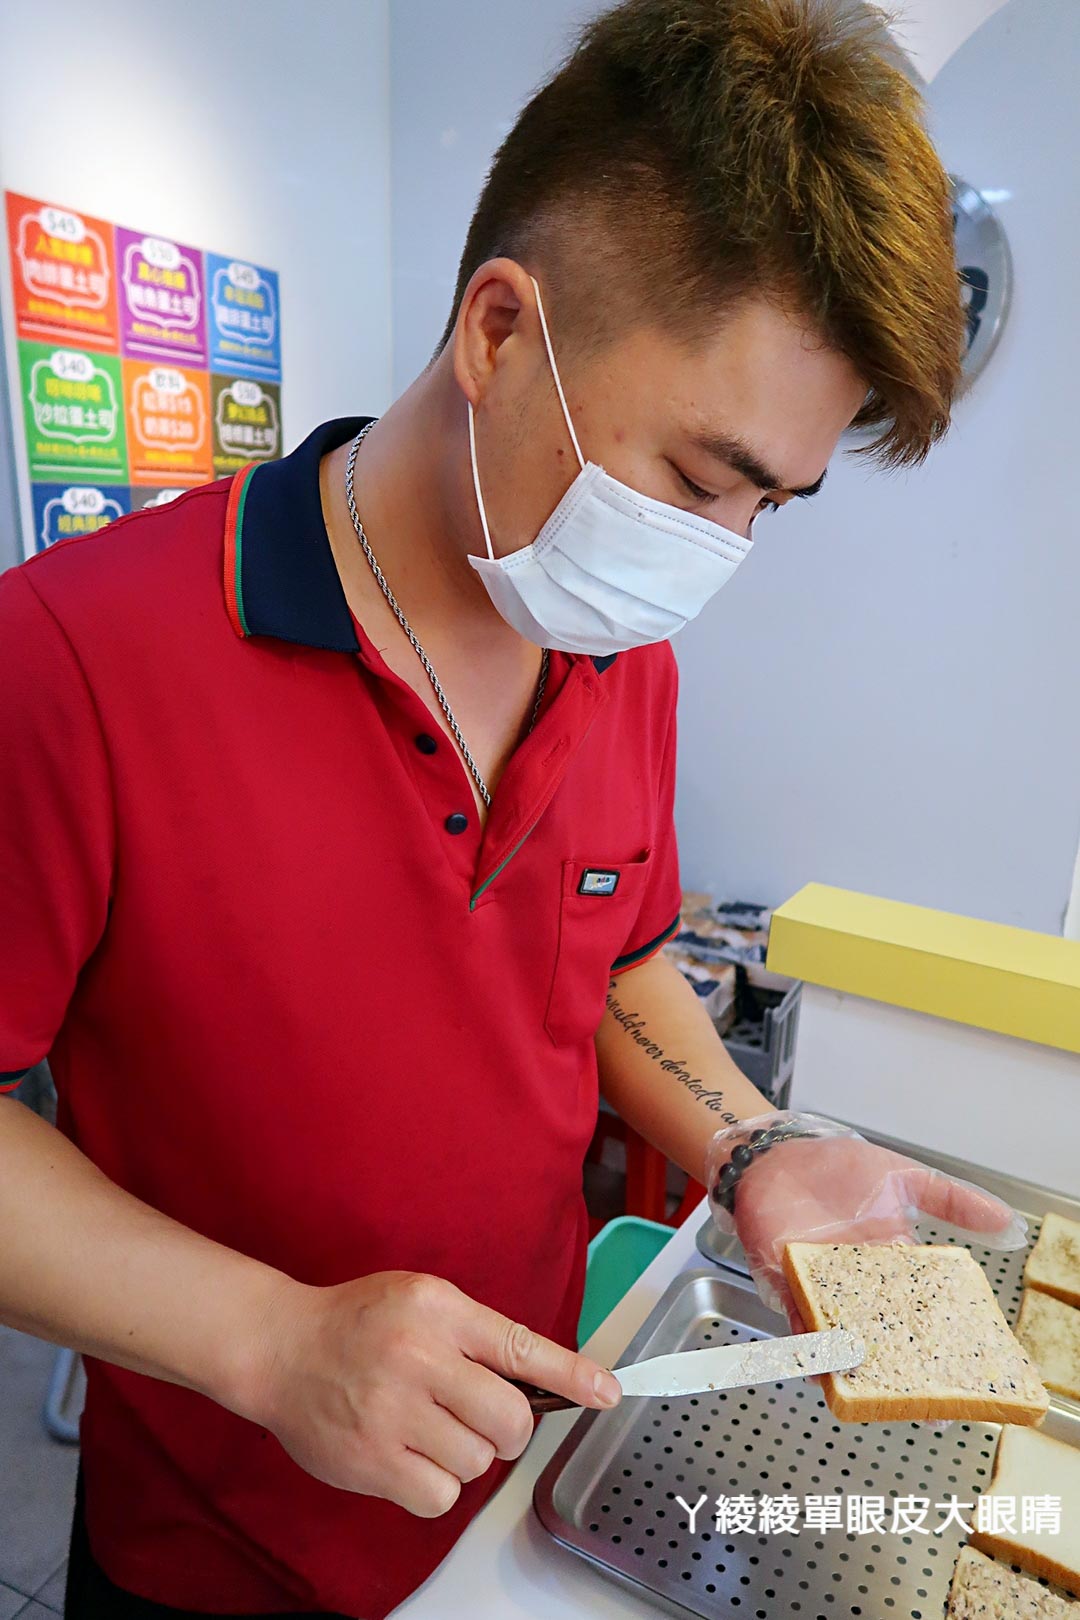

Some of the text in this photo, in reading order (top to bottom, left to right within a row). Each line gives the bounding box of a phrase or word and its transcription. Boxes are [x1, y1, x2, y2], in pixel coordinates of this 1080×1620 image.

[59, 354, 86, 374] $40
[72, 490, 97, 508] $40
[630, 1029, 664, 1060] never
[660, 1059, 723, 1101] devoted
[705, 1097, 723, 1112] to
